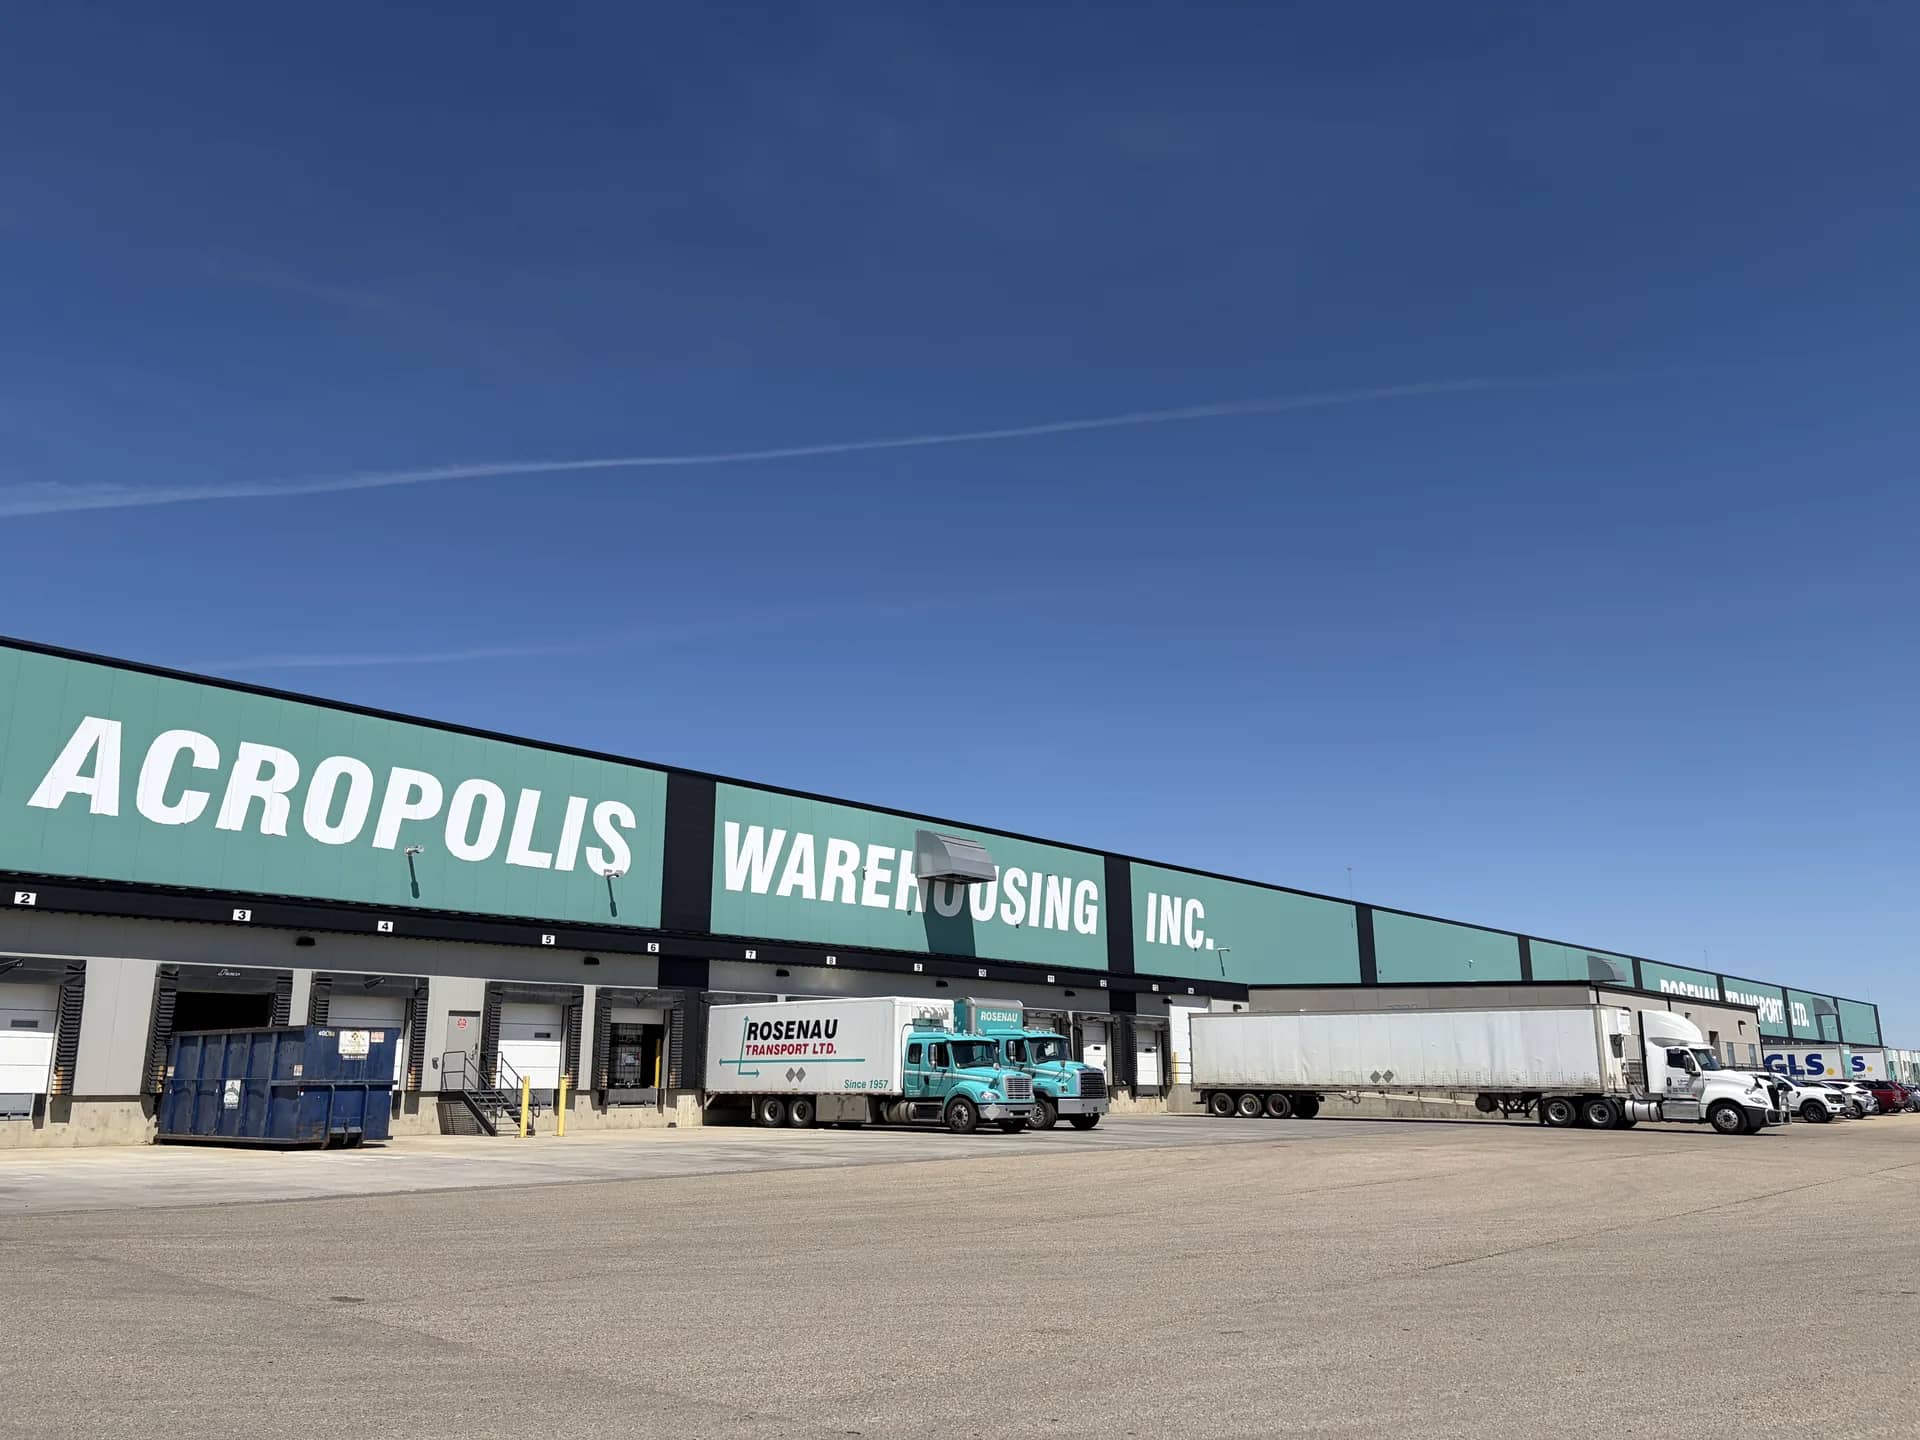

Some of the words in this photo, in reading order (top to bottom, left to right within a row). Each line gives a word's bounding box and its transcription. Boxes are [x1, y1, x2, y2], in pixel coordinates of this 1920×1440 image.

[27, 716, 638, 877] ACROPOLIS
[724, 821, 1099, 935] WAREHOUSING
[1146, 892, 1214, 950] INC.
[20, 893, 31, 904] 2
[237, 910, 247, 920] 3
[380, 922, 390, 931] 4
[980, 1011, 1018, 1022] ROSENAU
[1791, 1001, 1810, 1027] LTD.
[746, 1019, 838, 1041] ROSENAU
[745, 1043, 809, 1056] TRANSPORT
[812, 1042, 837, 1055] LTD.
[843, 1079, 867, 1089] Since
[868, 1079, 889, 1089] 1957
